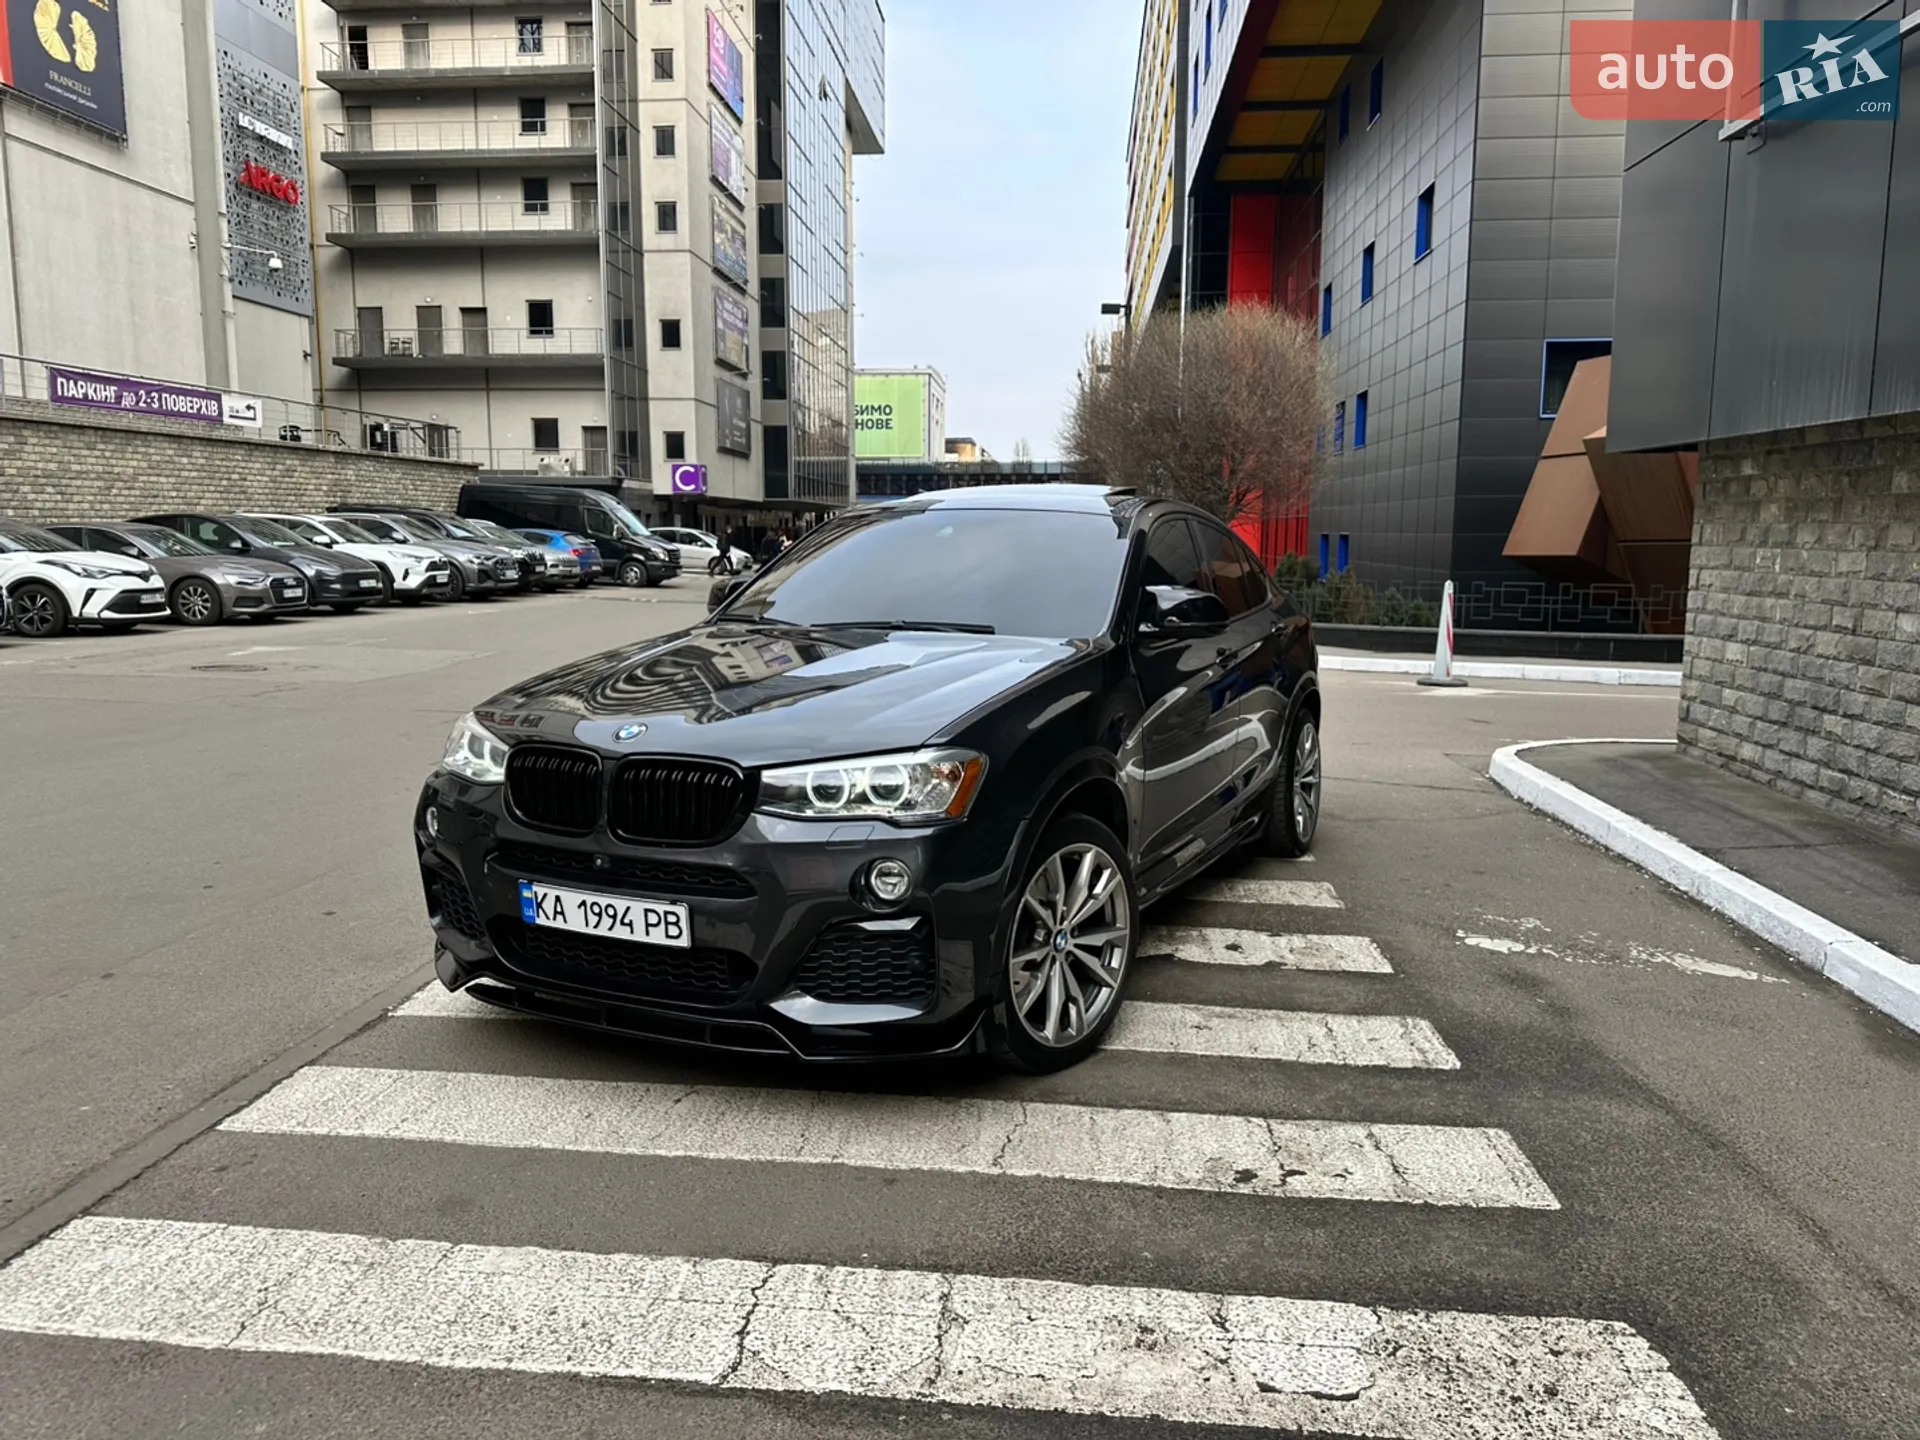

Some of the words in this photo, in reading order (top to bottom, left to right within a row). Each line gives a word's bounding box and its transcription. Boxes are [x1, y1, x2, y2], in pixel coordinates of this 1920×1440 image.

[49, 70, 91, 96] FRANCELLI
[240, 160, 299, 206] ARGO
[57, 377, 117, 403] ПАРКІНГ
[138, 390, 159, 408] 2-3
[162, 393, 219, 416] ПОВЕРХІВ
[534, 891, 567, 924] KA
[577, 899, 634, 934] 1994
[643, 908, 683, 940] PB
